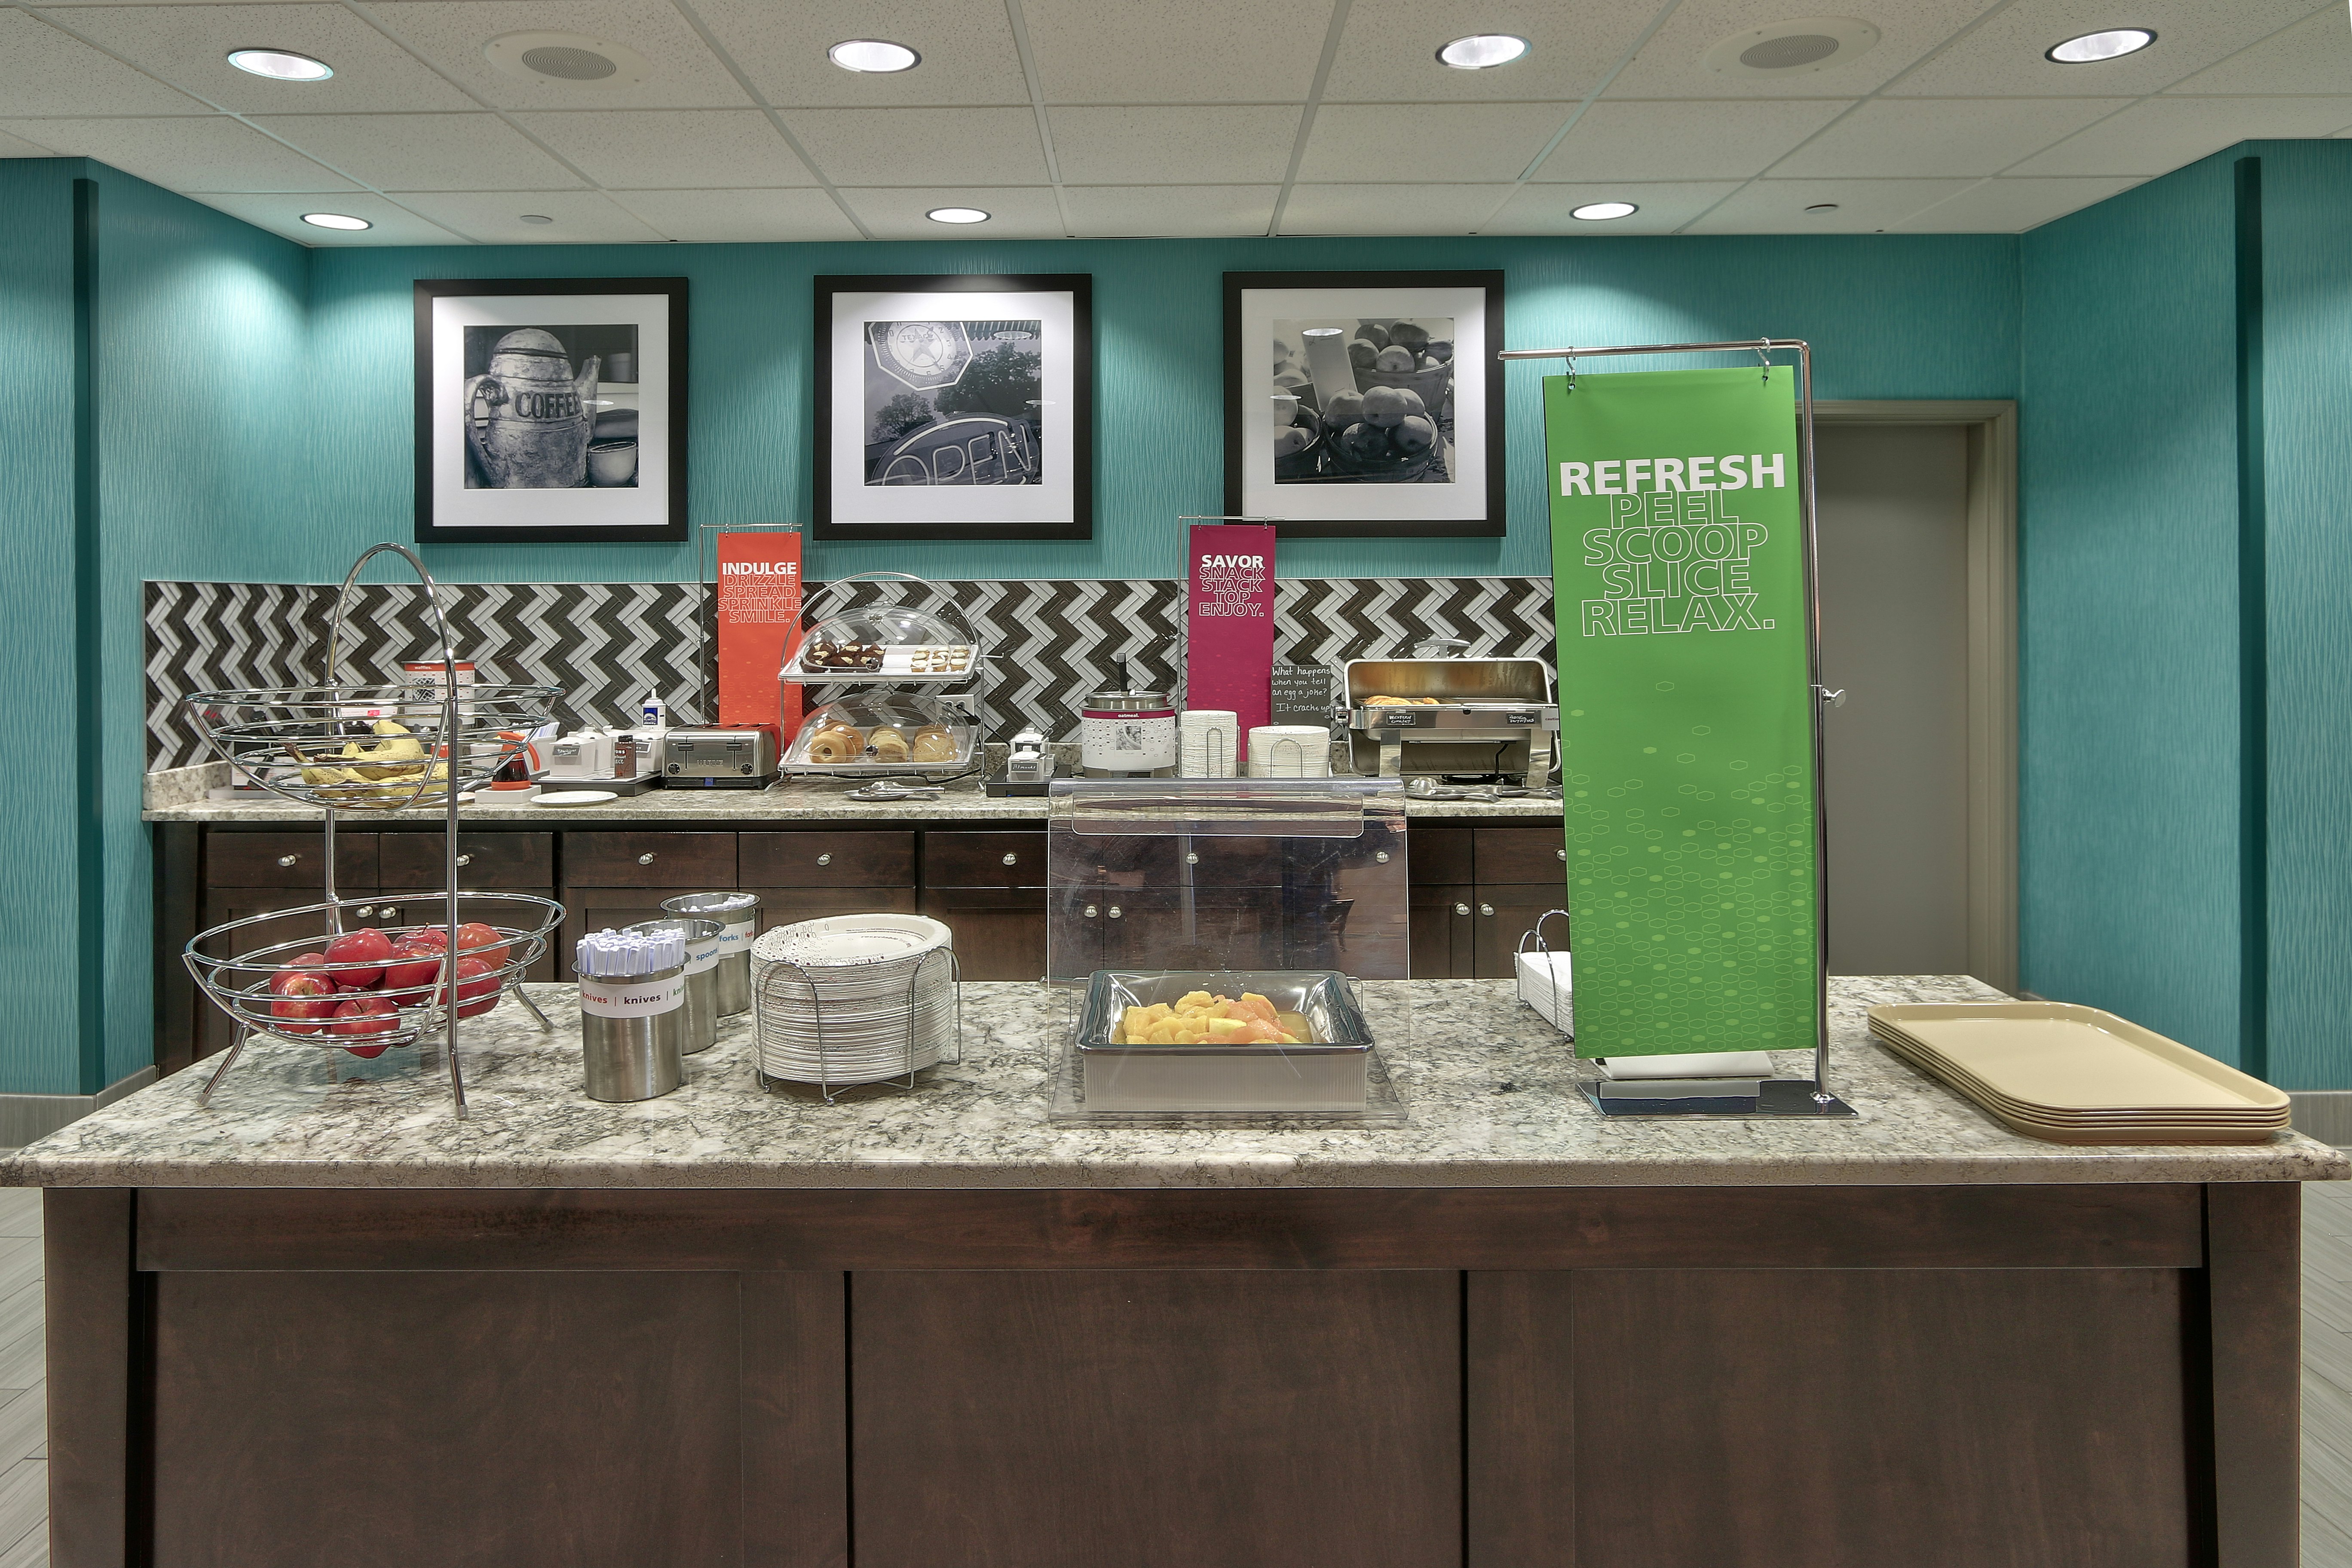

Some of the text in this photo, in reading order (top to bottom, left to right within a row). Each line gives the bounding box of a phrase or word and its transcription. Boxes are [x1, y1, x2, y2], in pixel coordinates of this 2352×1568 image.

[515, 392, 580, 418] COFFEE
[1560, 453, 1785, 496] REFRESH
[1610, 489, 1739, 529] PEEL
[1583, 522, 1768, 566] SCOOP
[1201, 554, 1263, 568] SAVOR
[723, 562, 796, 575] INDULGE
[1199, 567, 1265, 580] SNACK
[724, 573, 796, 586] DRIZZLE
[1202, 578, 1263, 592] STACK
[1602, 559, 1751, 600] SLICE
[723, 585, 796, 599] SPREAD
[1213, 590, 1251, 604] TOP
[718, 597, 801, 611] SPRINKLE
[1199, 602, 1265, 617] ENJOY.
[729, 609, 790, 623] SMILE.
[1582, 593, 1775, 637] RELAX.
[1272, 666, 1330, 677] What happens
[1284, 690, 1296, 700] egg
[1303, 688, 1327, 698] joke?
[1276, 703, 1291, 712] It
[696, 948, 718, 961] spoons
[582, 989, 607, 1004] knives
[624, 995, 661, 1004] knives
